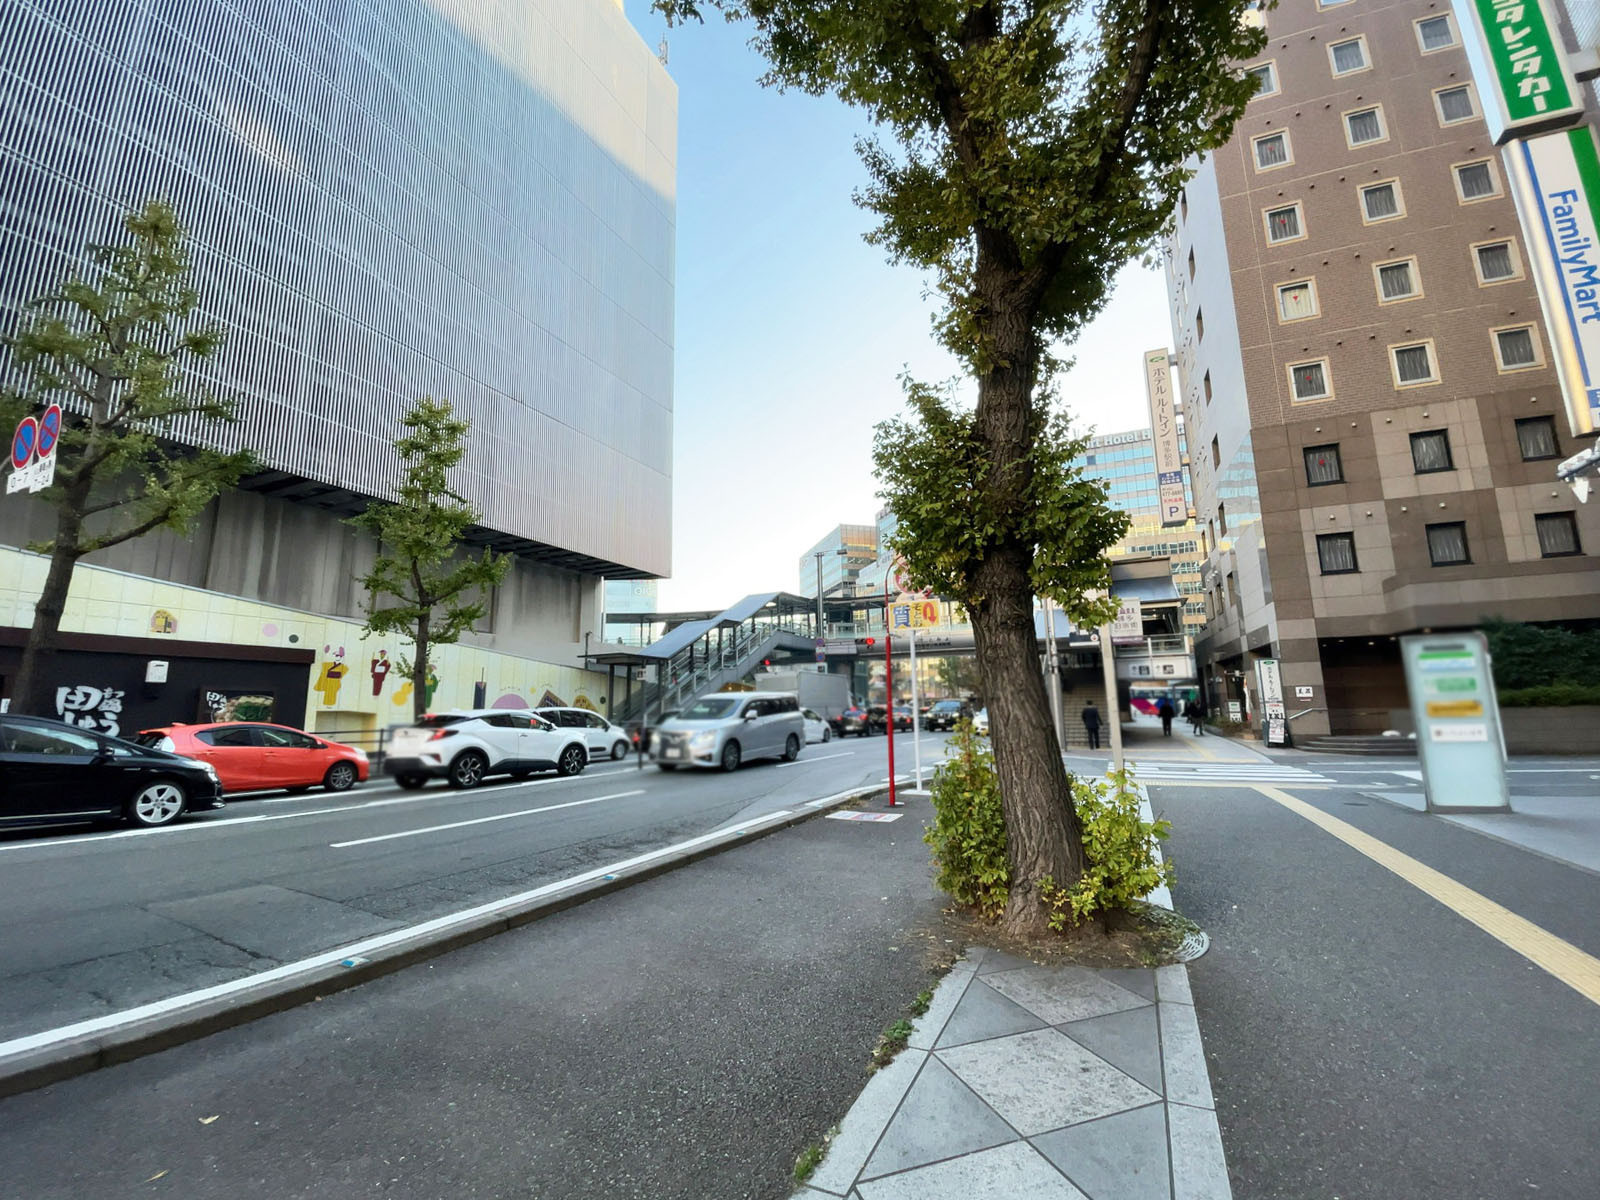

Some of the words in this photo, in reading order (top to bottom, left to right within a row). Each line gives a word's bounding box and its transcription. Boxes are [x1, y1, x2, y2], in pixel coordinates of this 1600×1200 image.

[1549, 189, 1600, 324] FamilyMart
[1152, 367, 1167, 395] ホテル
[1157, 398, 1171, 438] ルートイン
[1104, 432, 1138, 445] Hotel
[1169, 506, 1179, 517] P
[893, 605, 911, 628] 質
